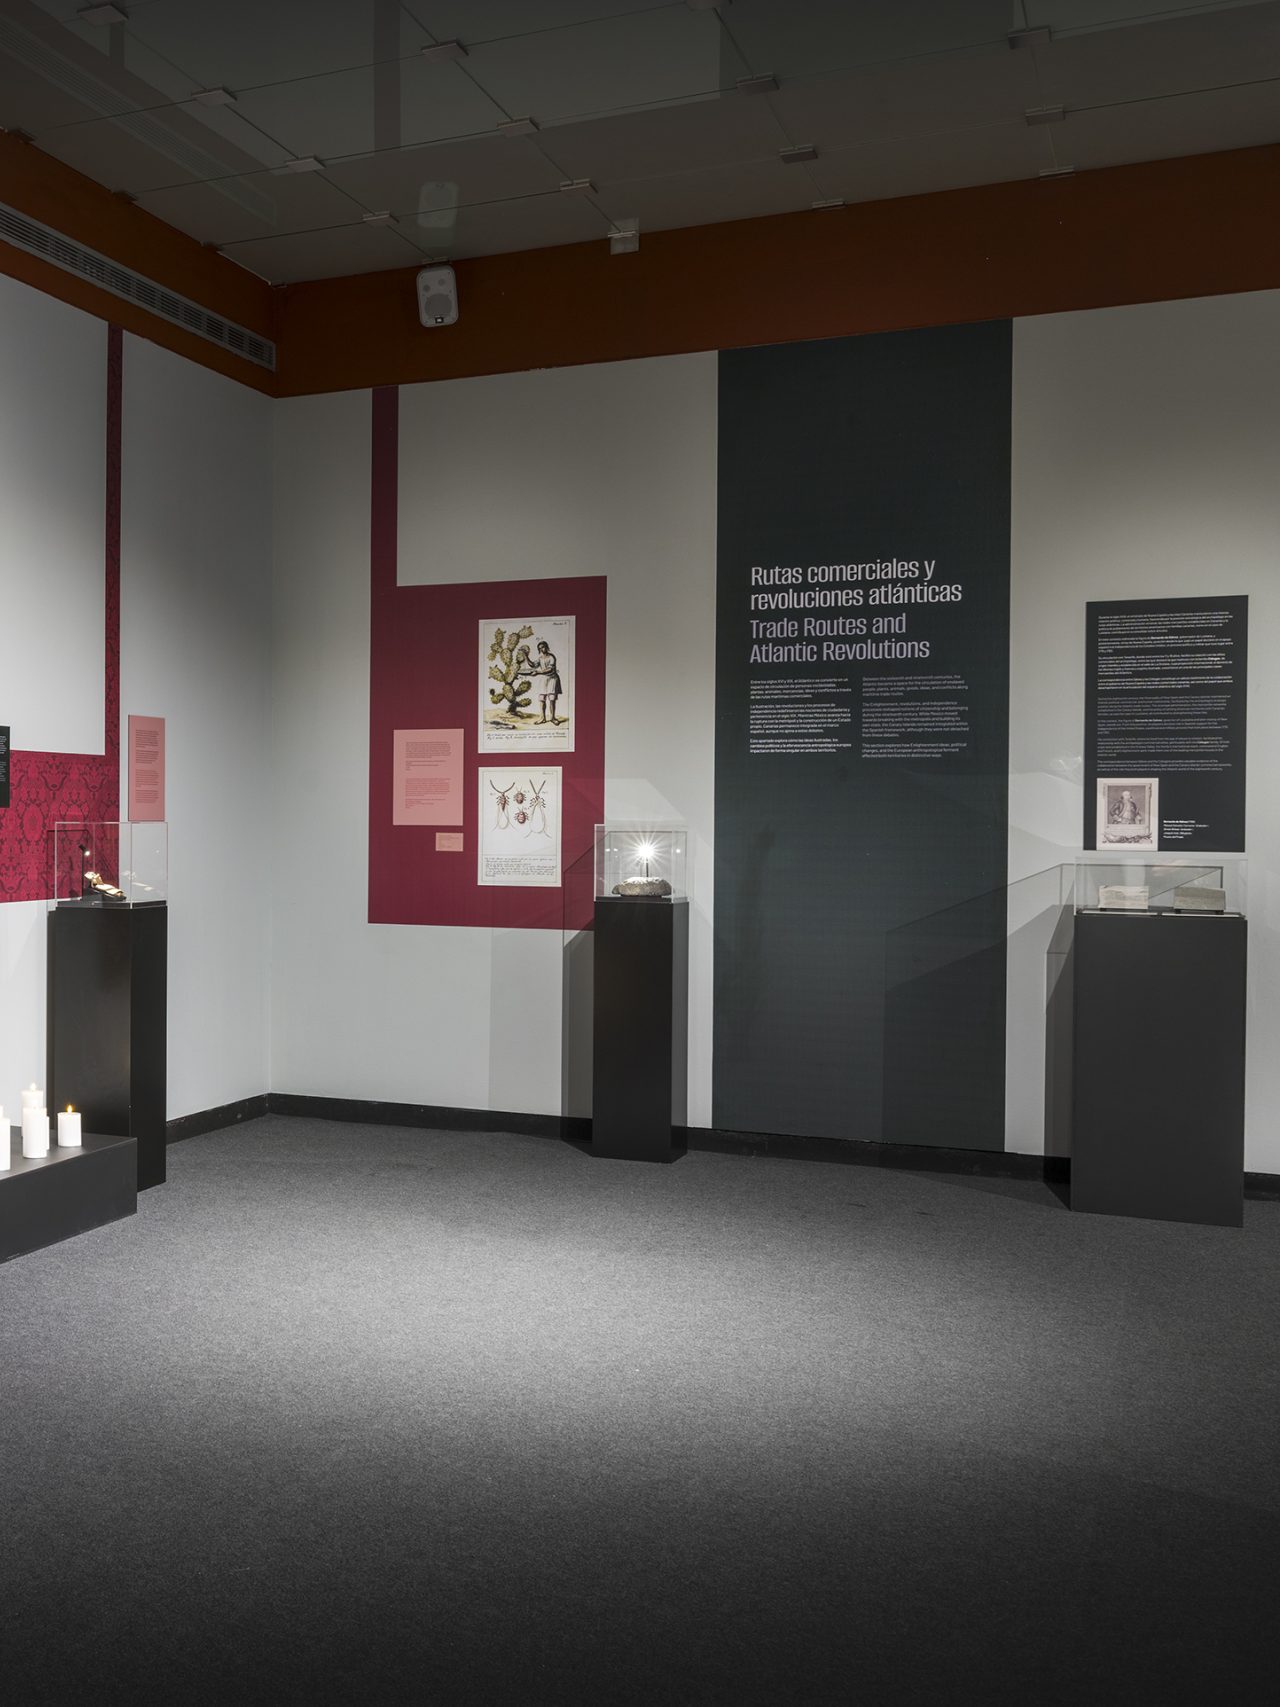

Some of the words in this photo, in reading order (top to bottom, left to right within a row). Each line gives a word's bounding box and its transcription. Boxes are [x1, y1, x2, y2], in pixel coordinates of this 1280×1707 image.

[751, 566, 802, 585] Rutas
[808, 558, 919, 583] comerciales
[923, 560, 935, 580] y
[750, 587, 864, 611] revoluciones
[869, 582, 962, 605] atlánticas
[749, 617, 799, 639] Trade
[803, 616, 867, 637] Routes
[872, 612, 907, 634] and
[749, 641, 818, 664] Atlantic
[822, 638, 931, 661] Revolutions
